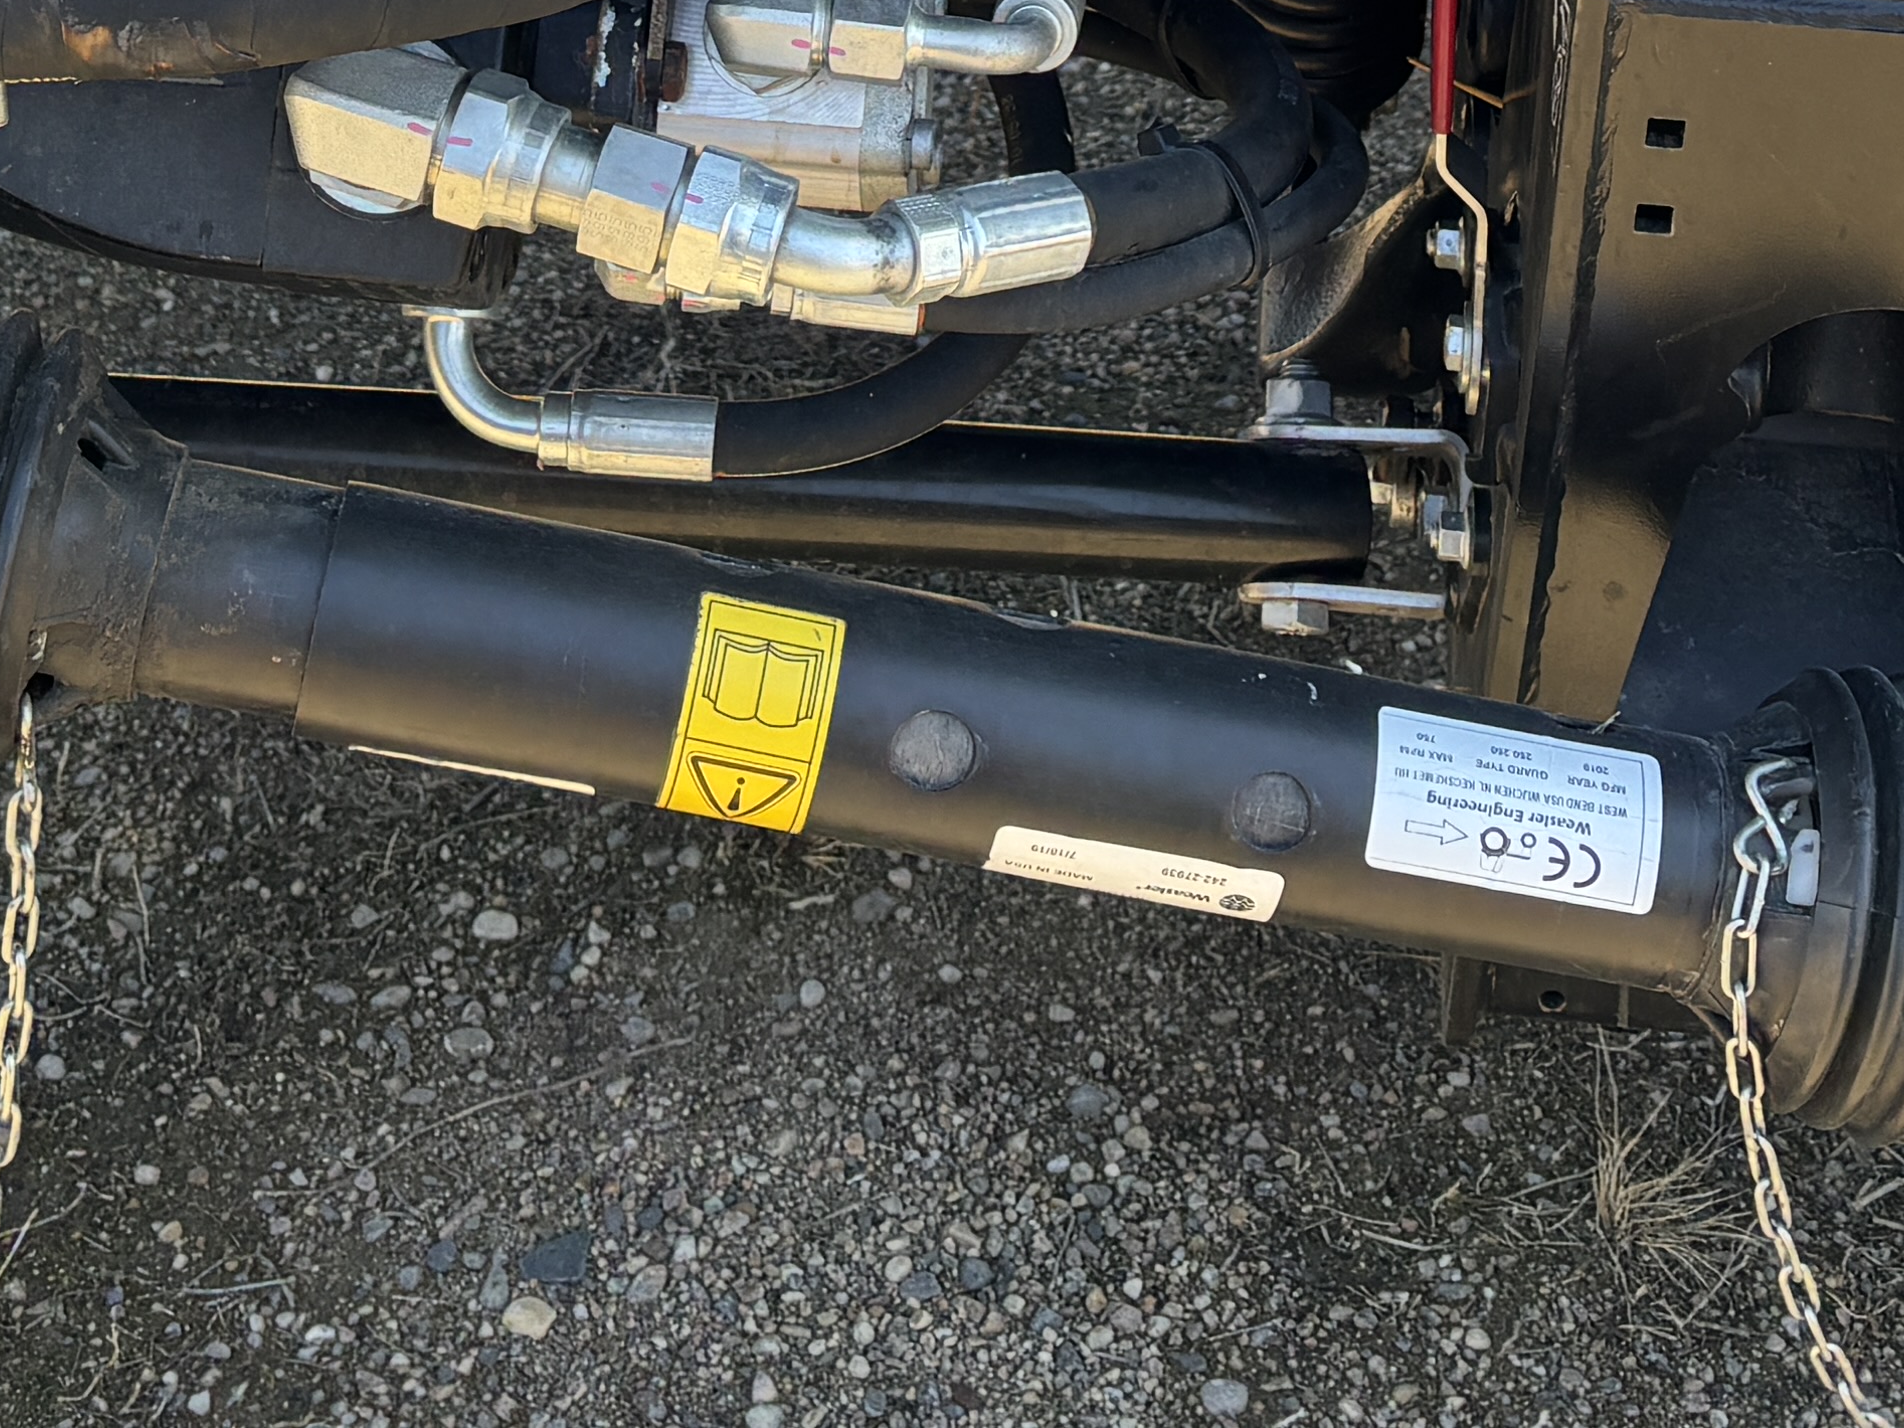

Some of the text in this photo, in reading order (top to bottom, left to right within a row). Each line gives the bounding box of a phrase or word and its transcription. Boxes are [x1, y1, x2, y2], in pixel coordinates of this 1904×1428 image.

[1399, 745, 1626, 795] MFG YEAR GUARD TYPE MAX RPM
[1426, 790, 1591, 837] Weasler Engineering
[1543, 793, 1565, 807] USA
[1566, 797, 1595, 813] BEND
[1597, 804, 1628, 818] WEST
[1542, 836, 1601, 889] CE
